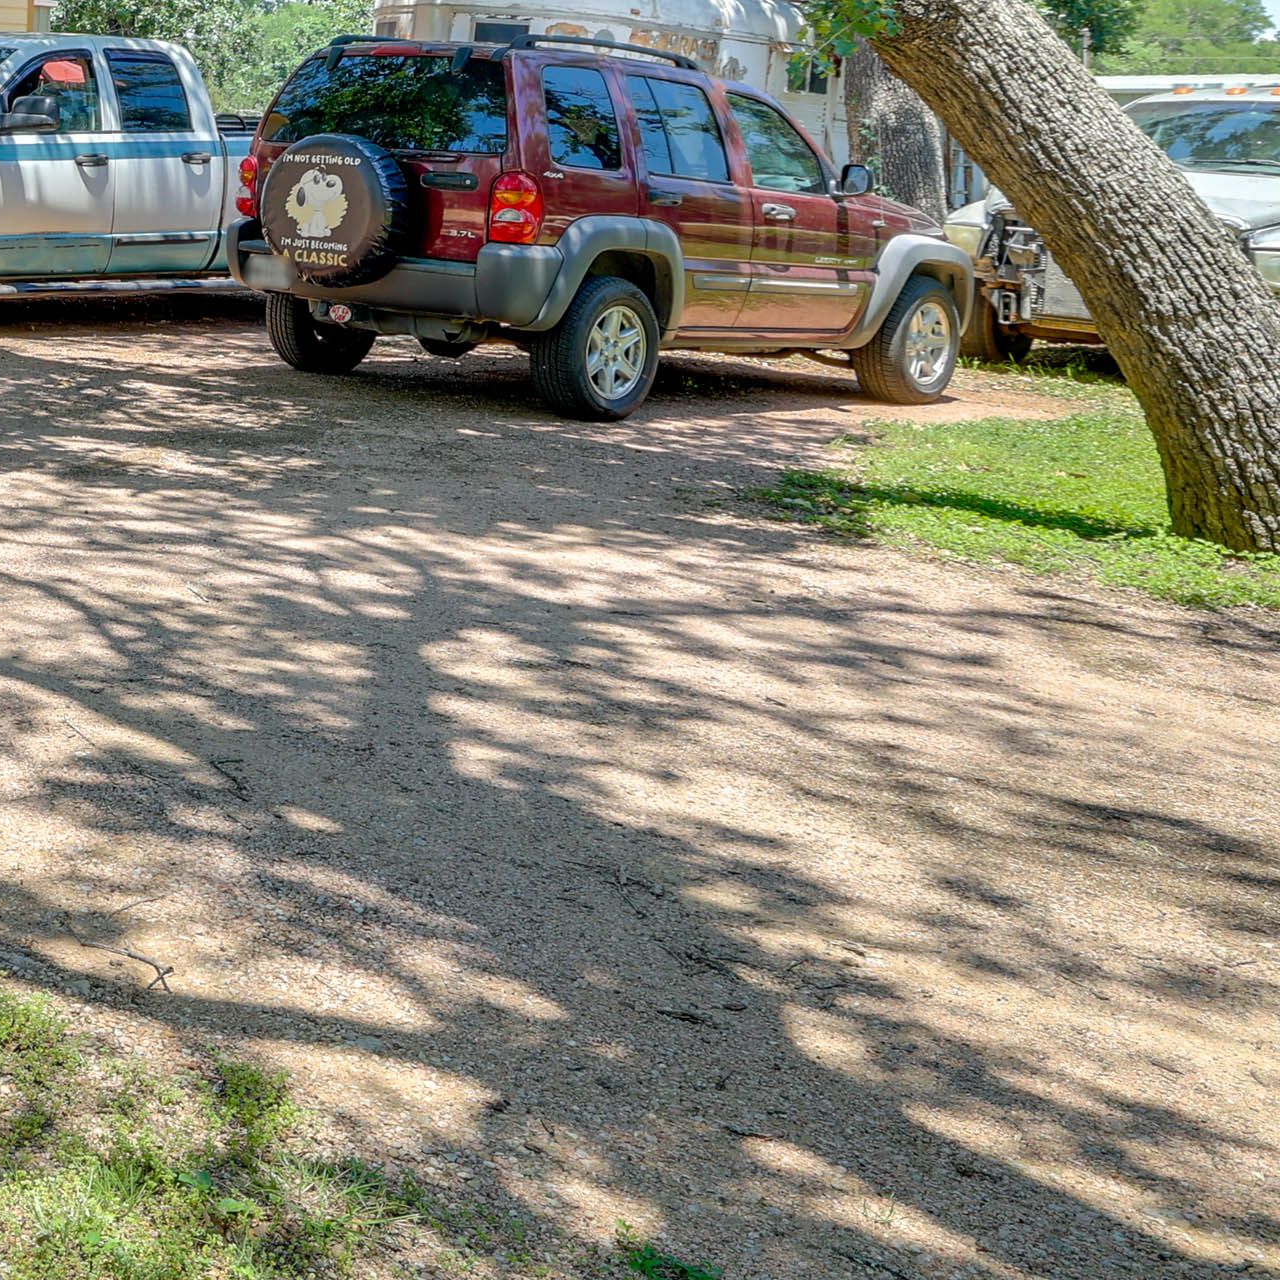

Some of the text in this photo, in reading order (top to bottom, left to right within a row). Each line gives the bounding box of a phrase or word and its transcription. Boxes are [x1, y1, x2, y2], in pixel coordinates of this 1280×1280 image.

[294, 154, 310, 164] NOT
[311, 155, 343, 166] GETTING
[344, 156, 362, 166] OLD
[448, 229, 476, 238] 3.7L
[292, 238, 310, 249] JUST
[310, 240, 348, 251] BECOMING
[283, 248, 348, 267] A CLASSIC
